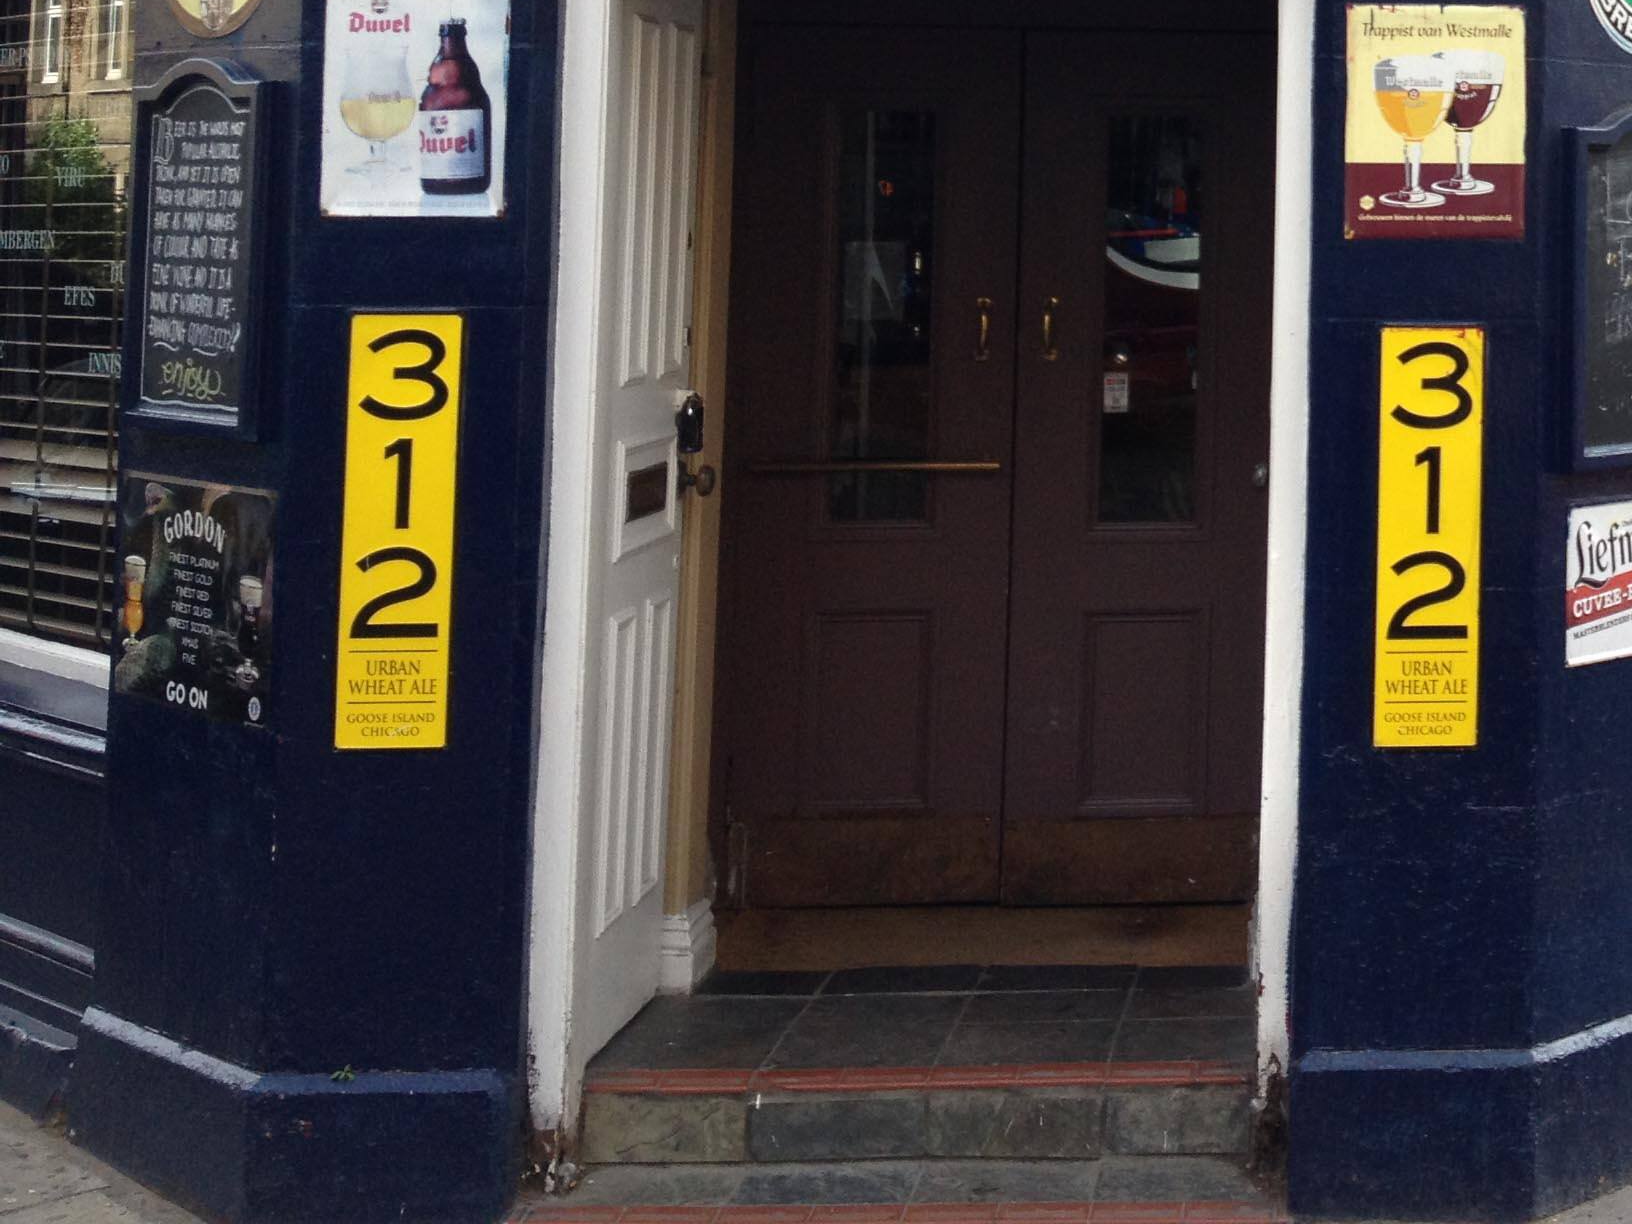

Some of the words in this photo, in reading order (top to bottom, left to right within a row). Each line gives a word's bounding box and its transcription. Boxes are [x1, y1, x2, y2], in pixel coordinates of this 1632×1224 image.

[349, 12, 411, 33] Duvel
[1361, 21, 1413, 40] Trappist
[1417, 27, 1442, 38] van
[1446, 23, 1513, 39] Westmalle
[64, 286, 96, 307] EFES
[164, 509, 226, 554] GORDON
[195, 573, 213, 586] GOLD
[366, 660, 421, 676] URBAN
[1402, 659, 1453, 677] URBAN
[166, 680, 186, 705] GO
[189, 687, 208, 710] ON
[348, 679, 406, 695] WHEAT
[409, 679, 438, 695] ALE
[1385, 679, 1439, 695] WHEAT
[1441, 678, 1468, 695] ALE
[346, 713, 389, 724] GOOSE
[392, 712, 435, 723] ISLAND
[1384, 711, 1422, 723] GOOSE
[1424, 711, 1466, 723] ISLAND
[1398, 725, 1453, 736] CHICAGO
